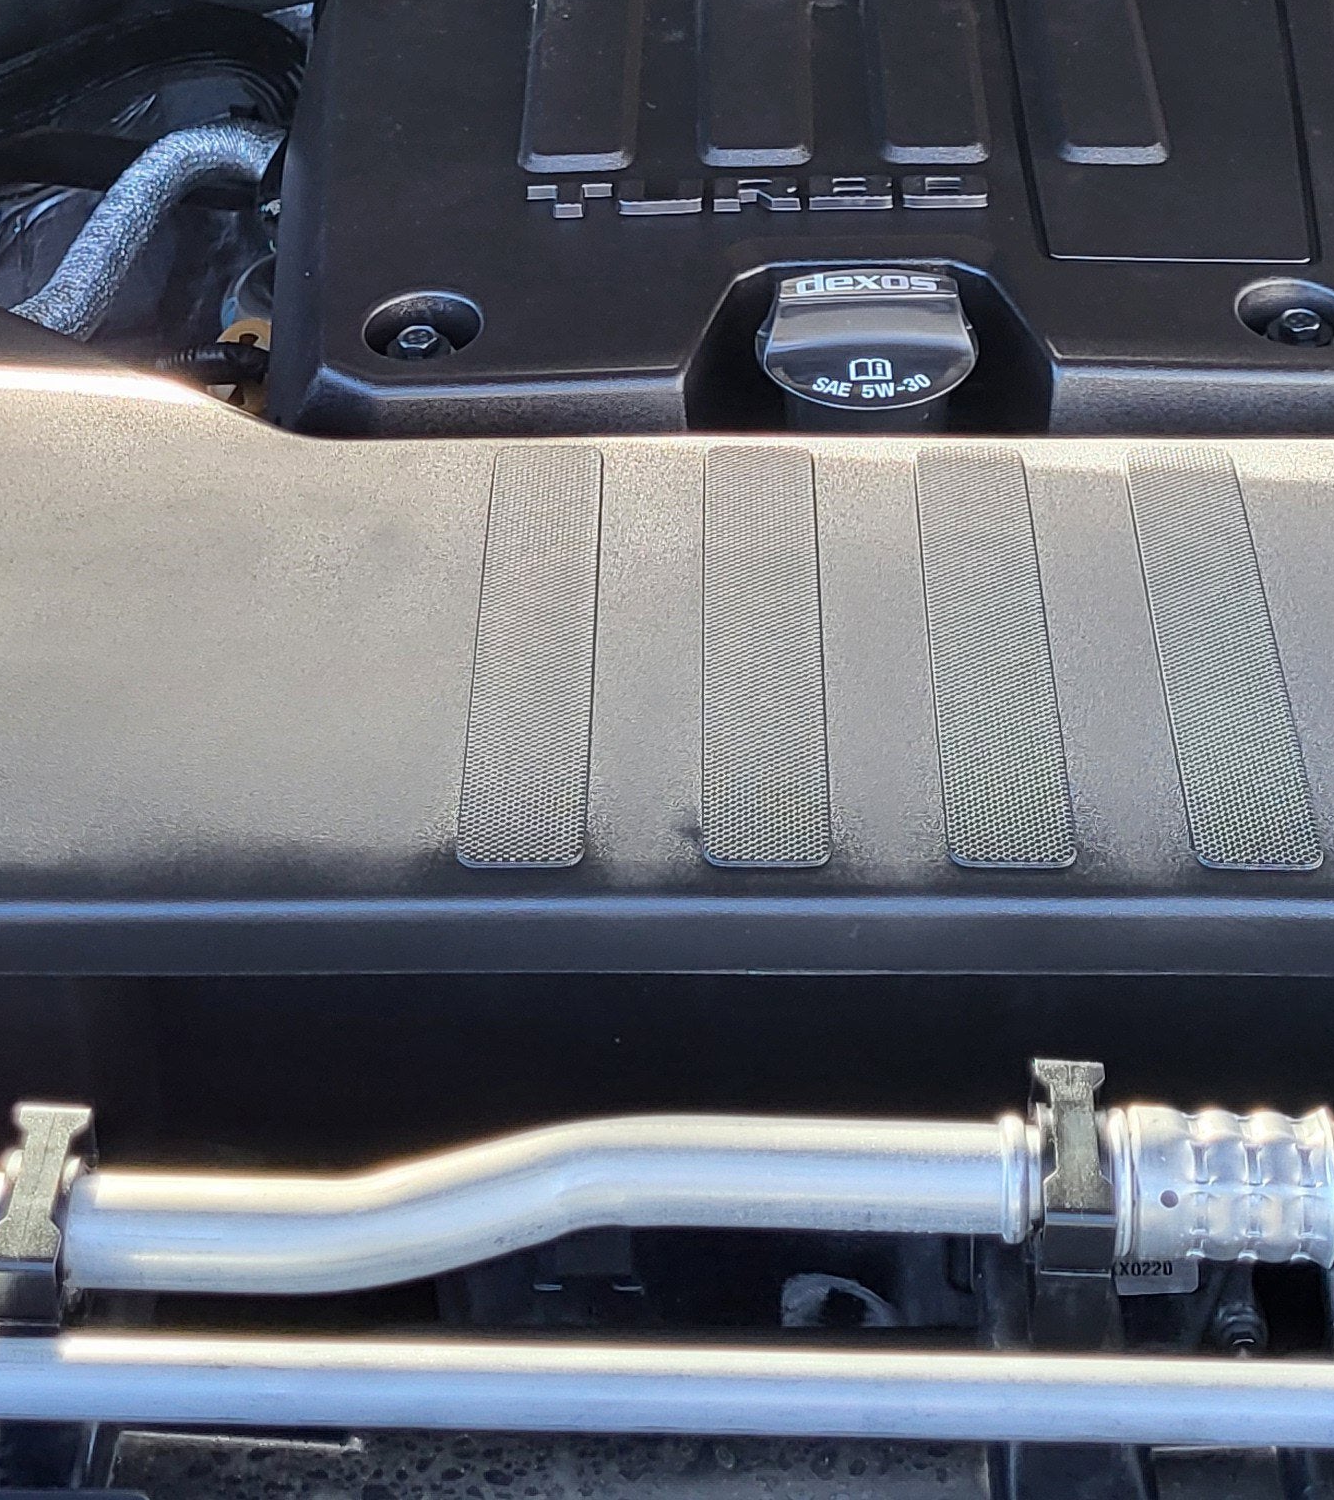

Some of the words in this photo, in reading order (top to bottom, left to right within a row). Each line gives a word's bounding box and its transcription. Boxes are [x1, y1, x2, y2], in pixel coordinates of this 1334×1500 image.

[525, 173, 990, 220] TURBO
[796, 273, 941, 295] dexos
[811, 376, 854, 399] SAE
[861, 373, 932, 399] 5W-30
